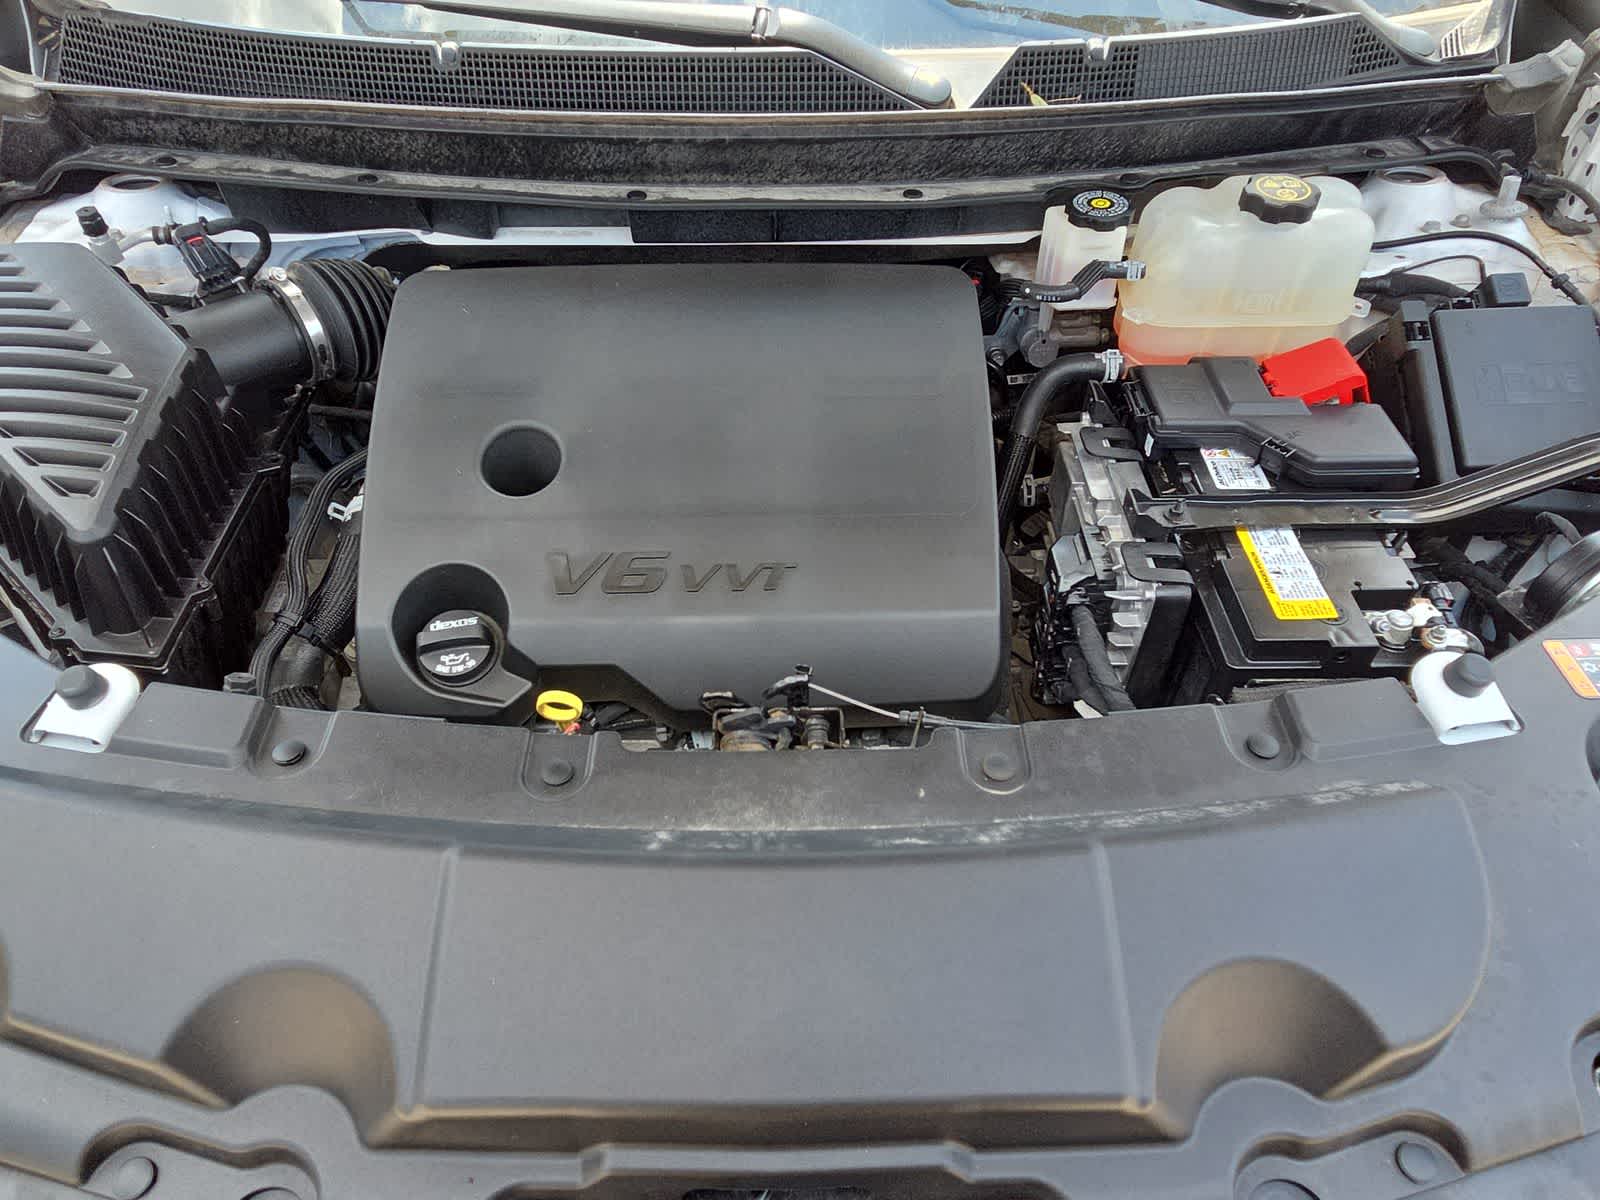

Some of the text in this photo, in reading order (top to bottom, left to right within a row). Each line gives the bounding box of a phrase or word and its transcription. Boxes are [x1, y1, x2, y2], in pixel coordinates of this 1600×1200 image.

[547, 551, 798, 595] V6 VVT
[430, 617, 479, 631] dexos
